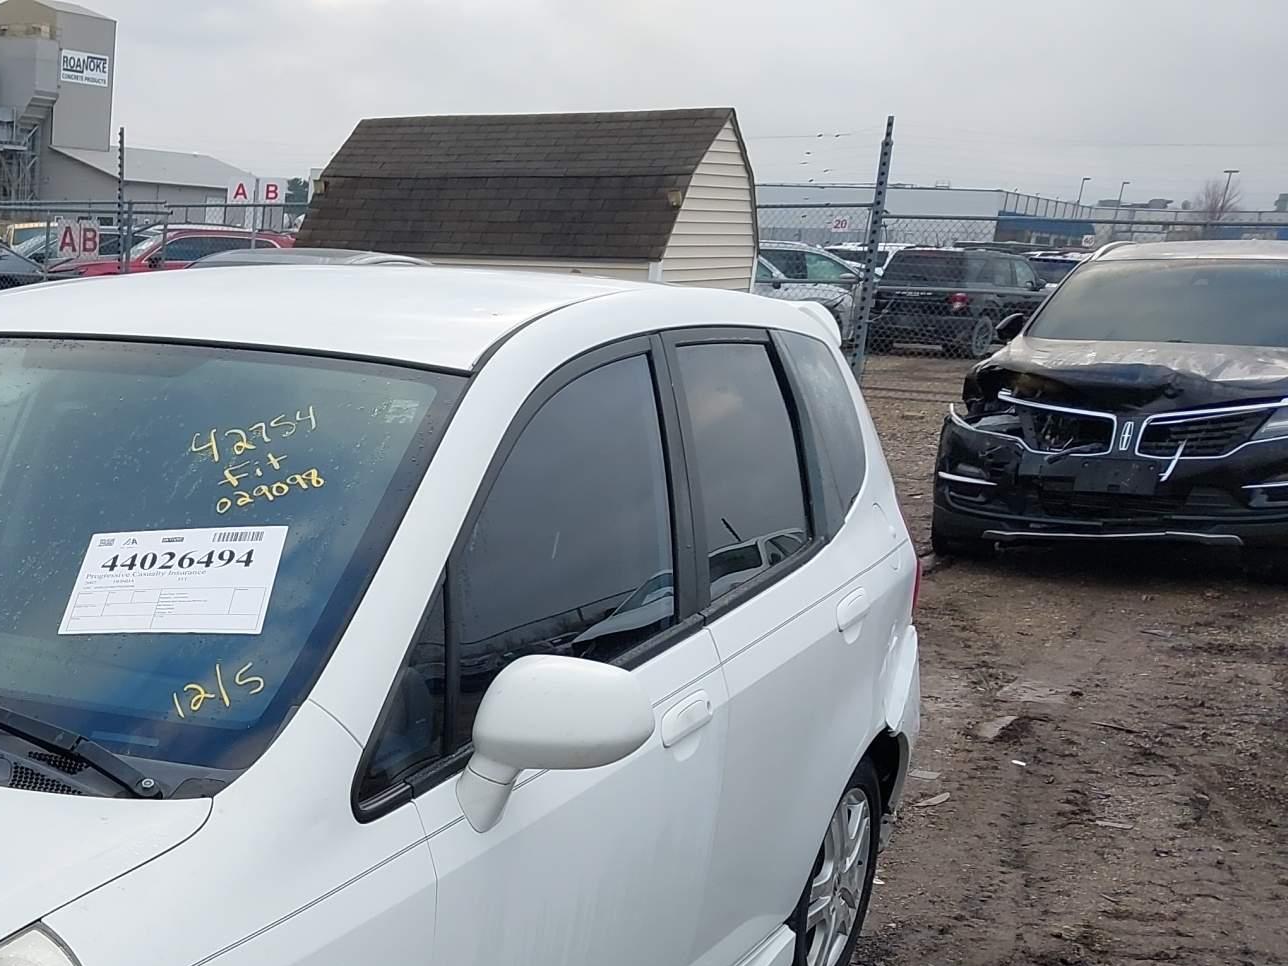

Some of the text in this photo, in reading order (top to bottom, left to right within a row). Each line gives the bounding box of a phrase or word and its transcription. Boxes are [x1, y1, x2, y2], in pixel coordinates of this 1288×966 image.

[62, 56, 107, 74] ROANOKE
[233, 183, 279, 200] A B
[833, 219, 848, 229] 20
[59, 226, 98, 252] A B
[191, 405, 317, 462] 42754
[216, 468, 325, 514] 029098
[100, 548, 255, 572] 44026494
[173, 662, 265, 718] 12/5
